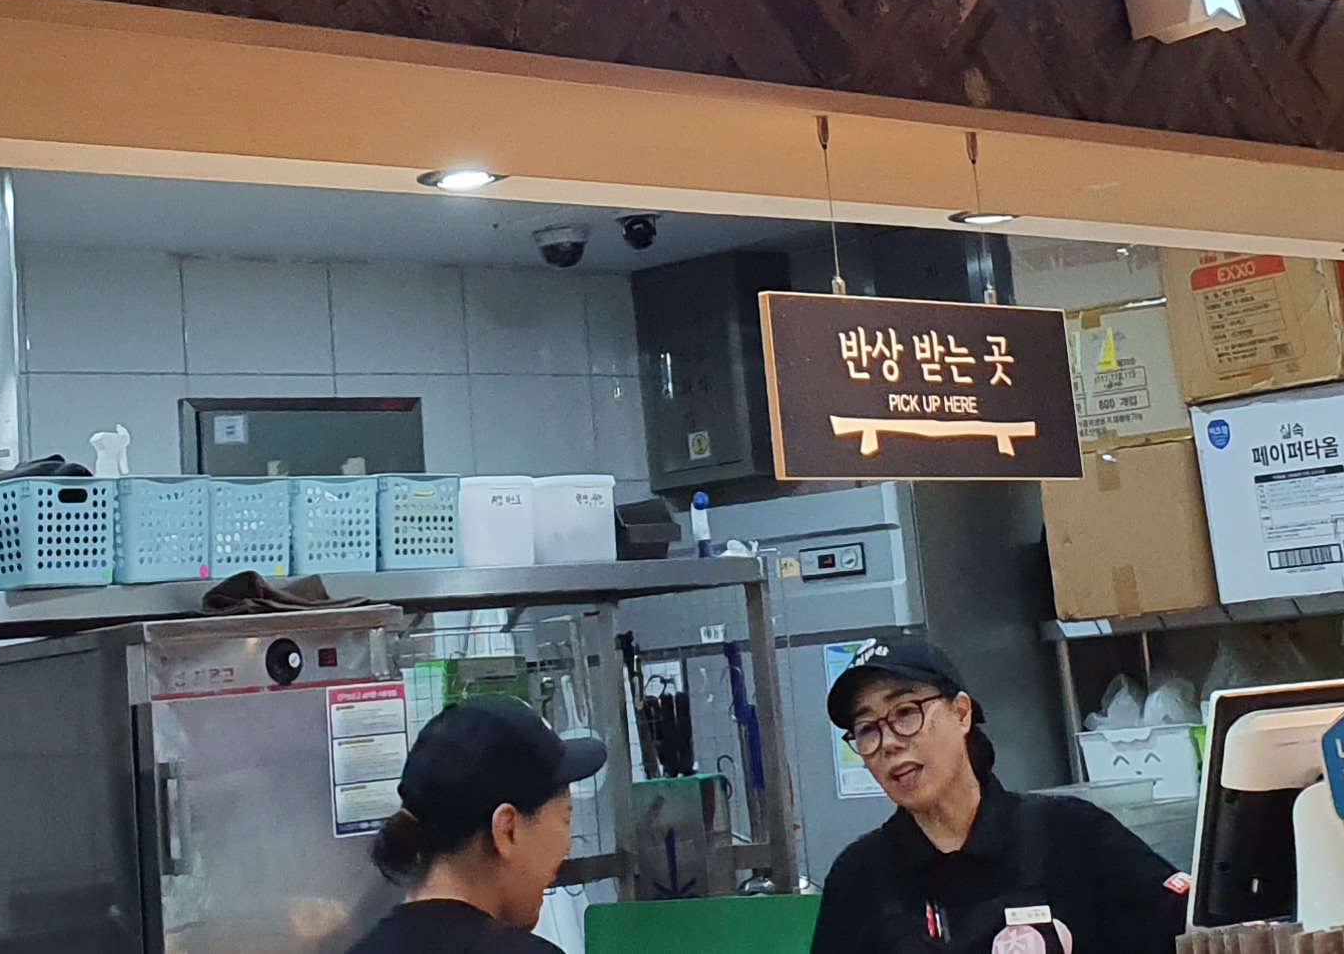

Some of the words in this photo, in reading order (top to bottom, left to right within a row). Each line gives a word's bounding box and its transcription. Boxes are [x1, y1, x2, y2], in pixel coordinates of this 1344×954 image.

[838, 327, 903, 382] 반상
[912, 330, 976, 385] 받는
[984, 335, 1015, 386] 곳
[888, 393, 921, 413] PICK
[922, 395, 940, 413] UP
[944, 395, 979, 414] HERE
[1279, 423, 1304, 439] 실속
[1251, 436, 1339, 466] 페이퍼타올
